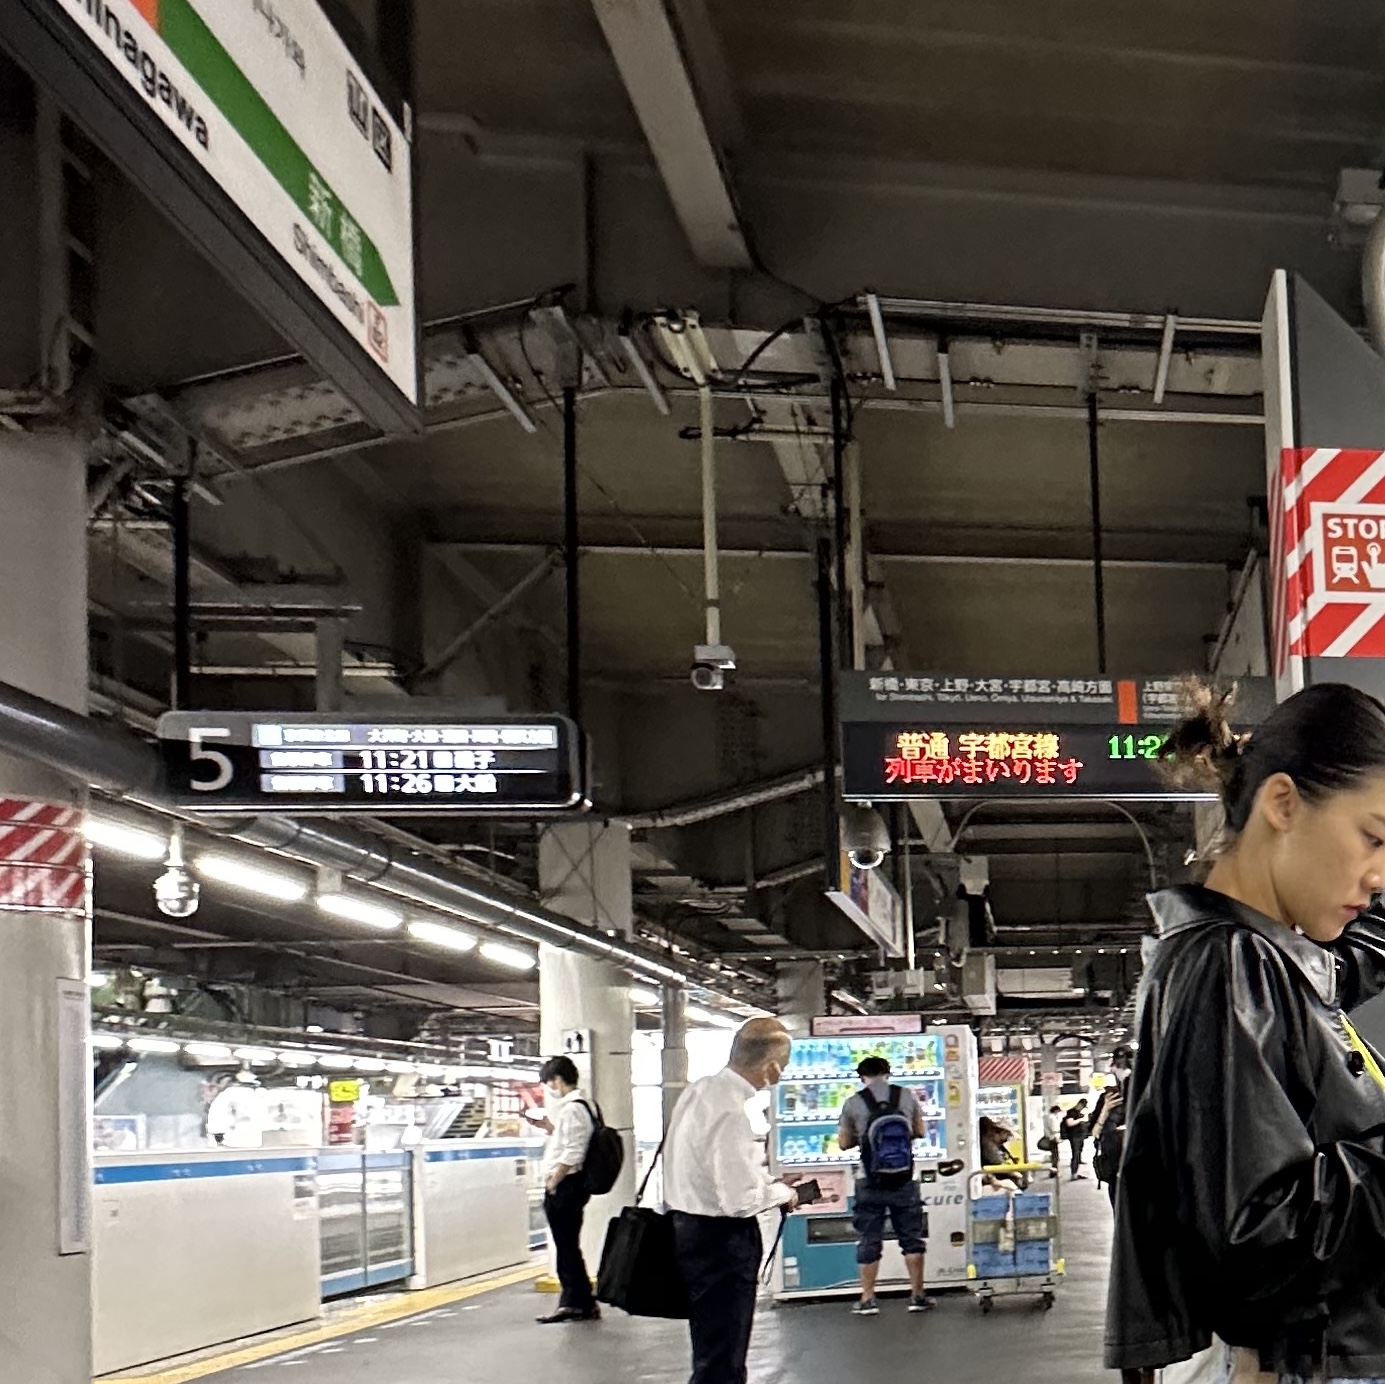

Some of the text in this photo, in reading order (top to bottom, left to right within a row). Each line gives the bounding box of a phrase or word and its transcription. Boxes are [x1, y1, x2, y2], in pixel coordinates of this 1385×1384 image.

[359, 750, 429, 768] 11:21
[897, 733, 1175, 759] 普通 宇都宮線 11:2
[189, 728, 234, 791] 5
[885, 758, 1083, 784] 列車がまいります
[360, 774, 432, 793] 11:26
